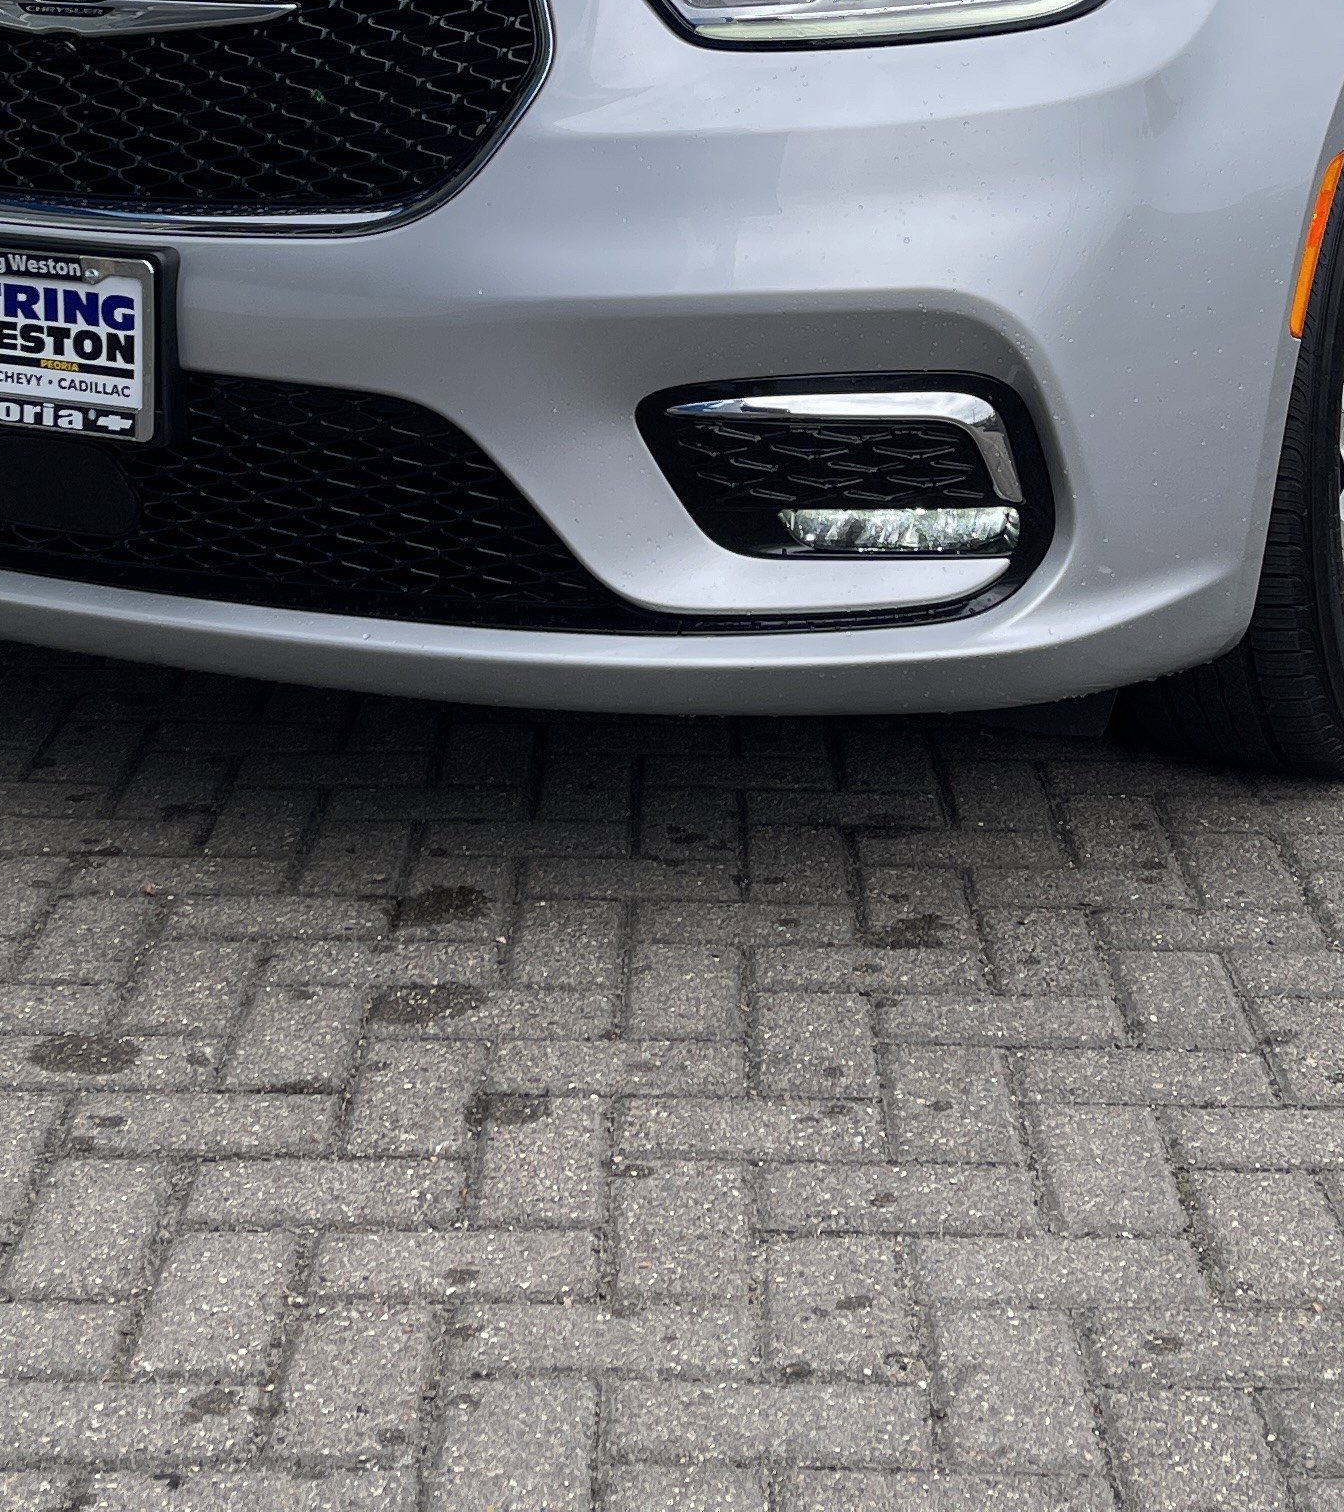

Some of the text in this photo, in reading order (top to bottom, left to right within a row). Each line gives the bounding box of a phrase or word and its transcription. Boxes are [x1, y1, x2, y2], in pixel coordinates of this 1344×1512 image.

[25, 5, 104, 16] CHRYSLER
[7, 253, 81, 277] Weston
[40, 359, 80, 372] PEORIA
[57, 377, 131, 398] CADILLAC
